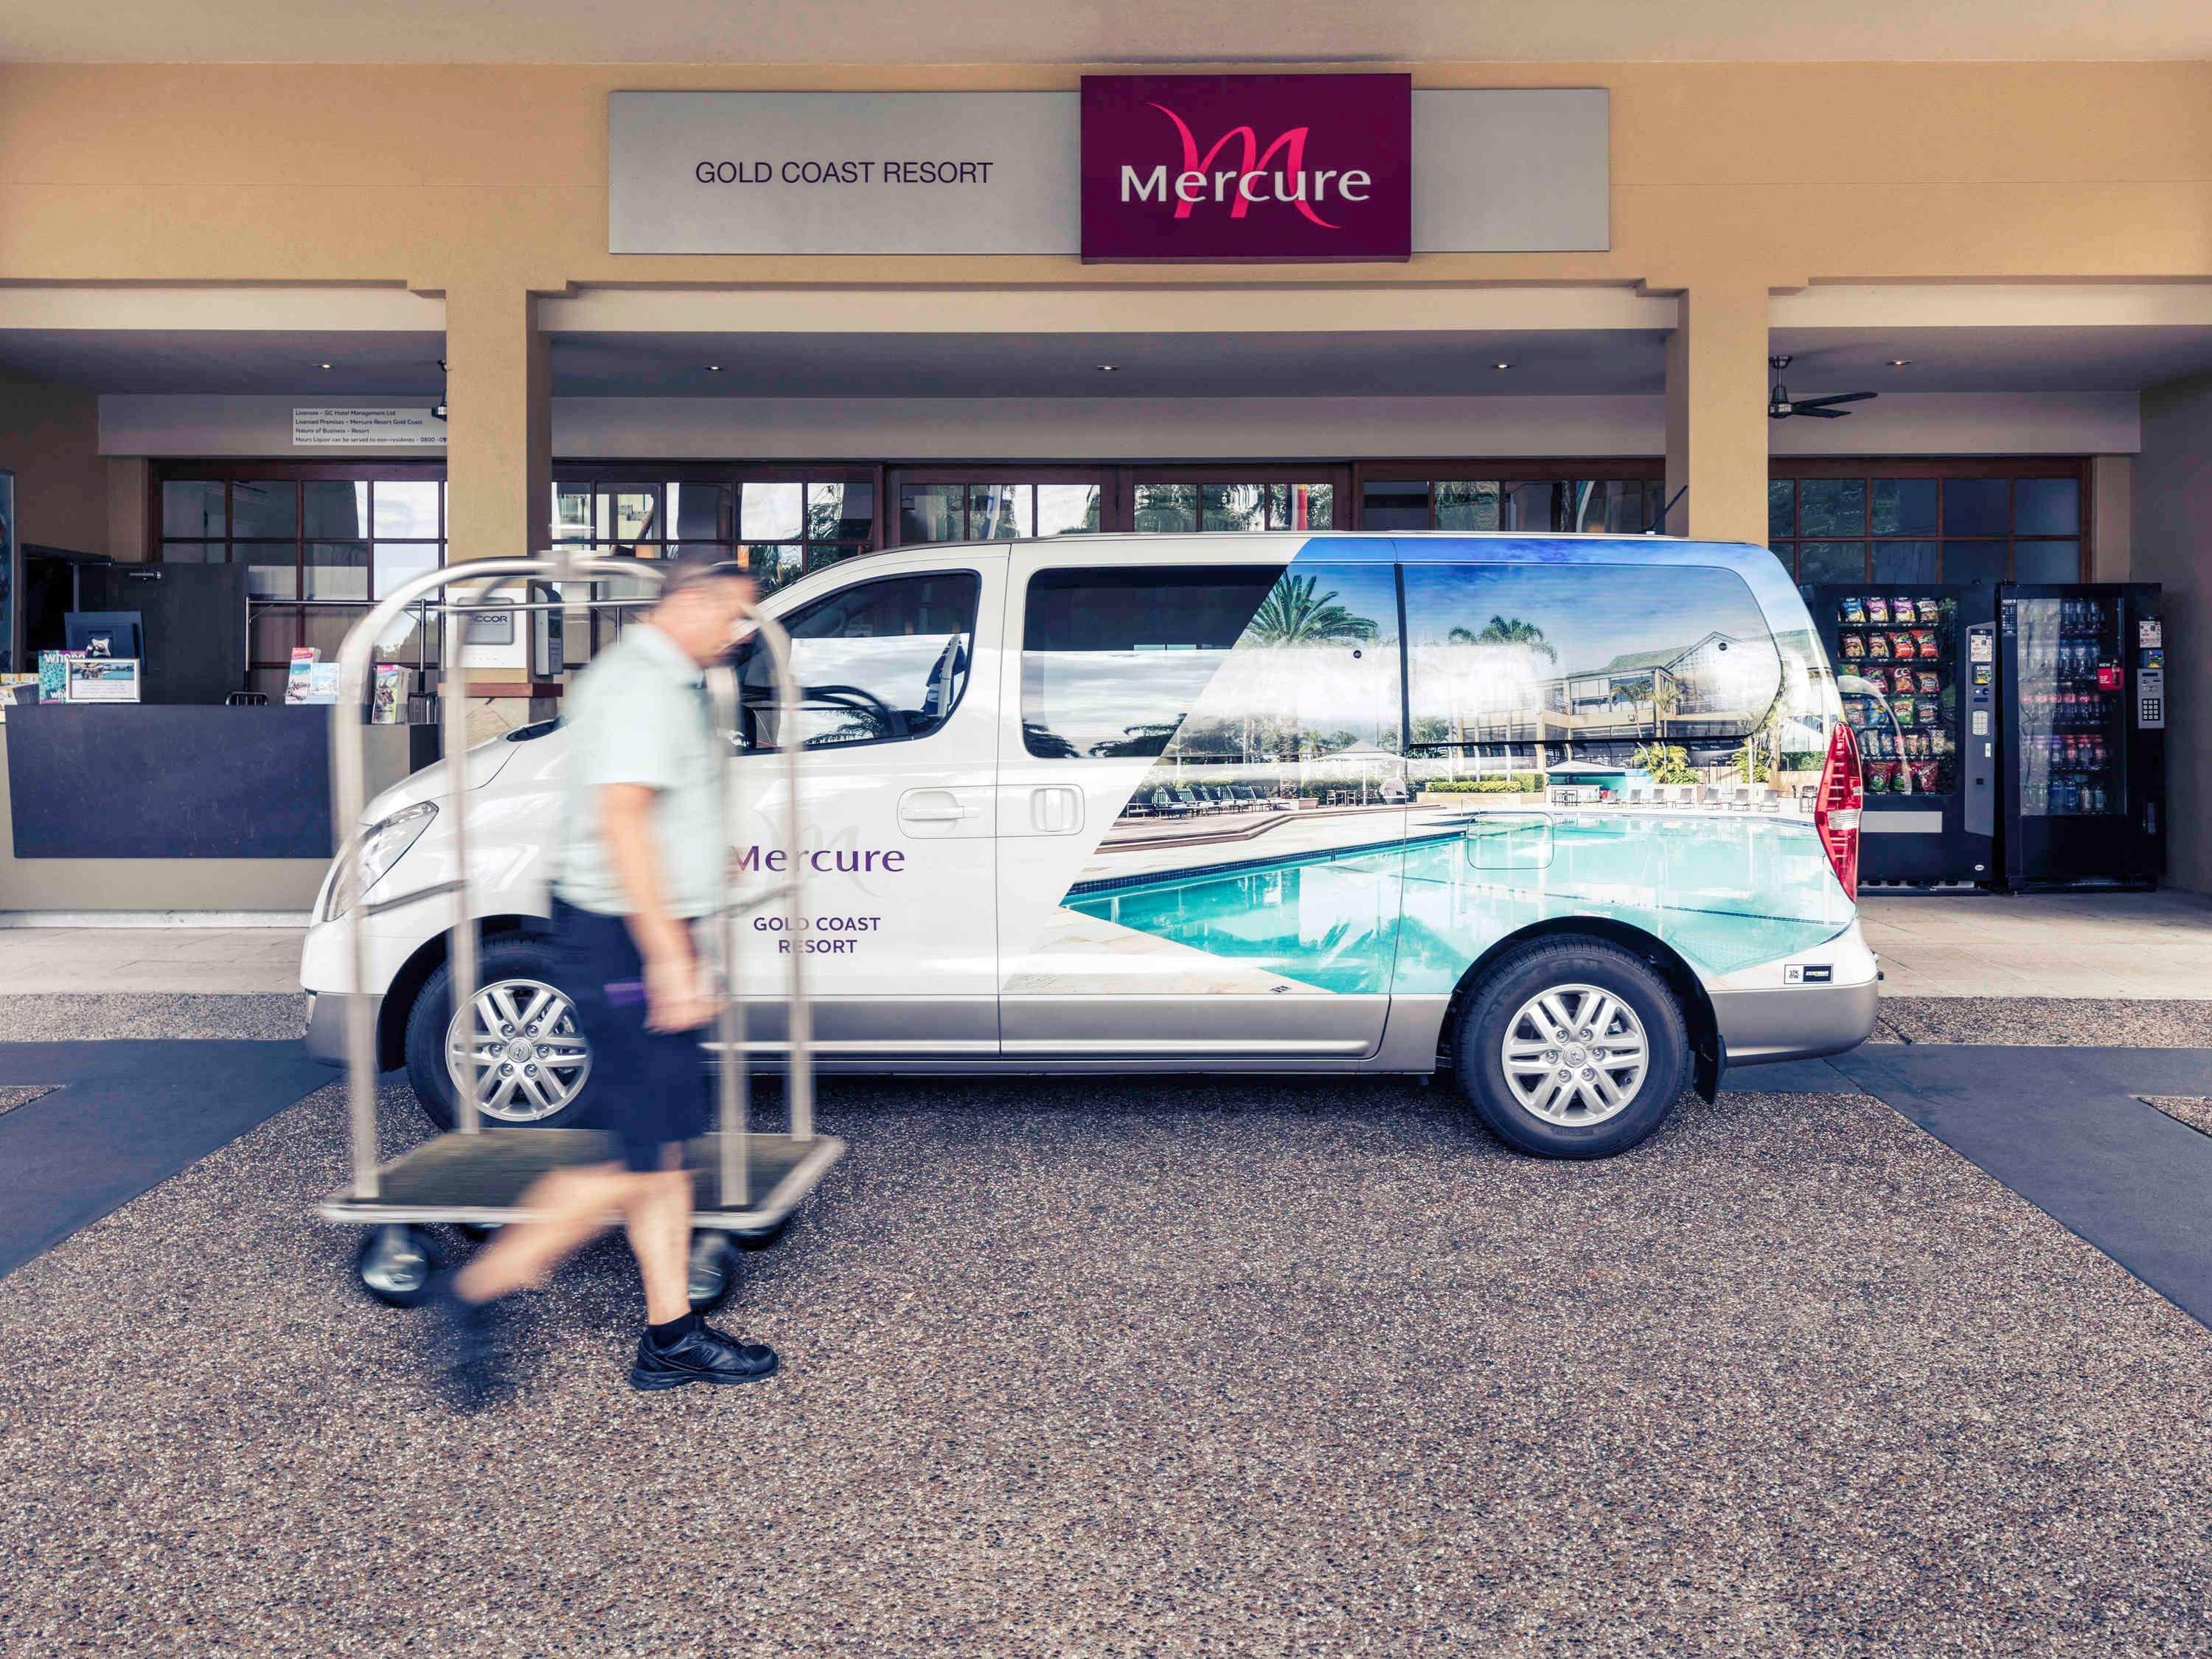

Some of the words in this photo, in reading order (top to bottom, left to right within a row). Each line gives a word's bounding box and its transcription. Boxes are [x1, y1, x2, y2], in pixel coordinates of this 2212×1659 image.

[695, 161, 773, 184] GOLD
[782, 161, 875, 184] COAST
[884, 161, 994, 184] RESORT
[1121, 164, 1371, 202] Mercure
[731, 845, 905, 872] Mercure
[754, 917, 809, 931] GOLD
[815, 917, 881, 931] COAST
[779, 939, 858, 953] RESORT
